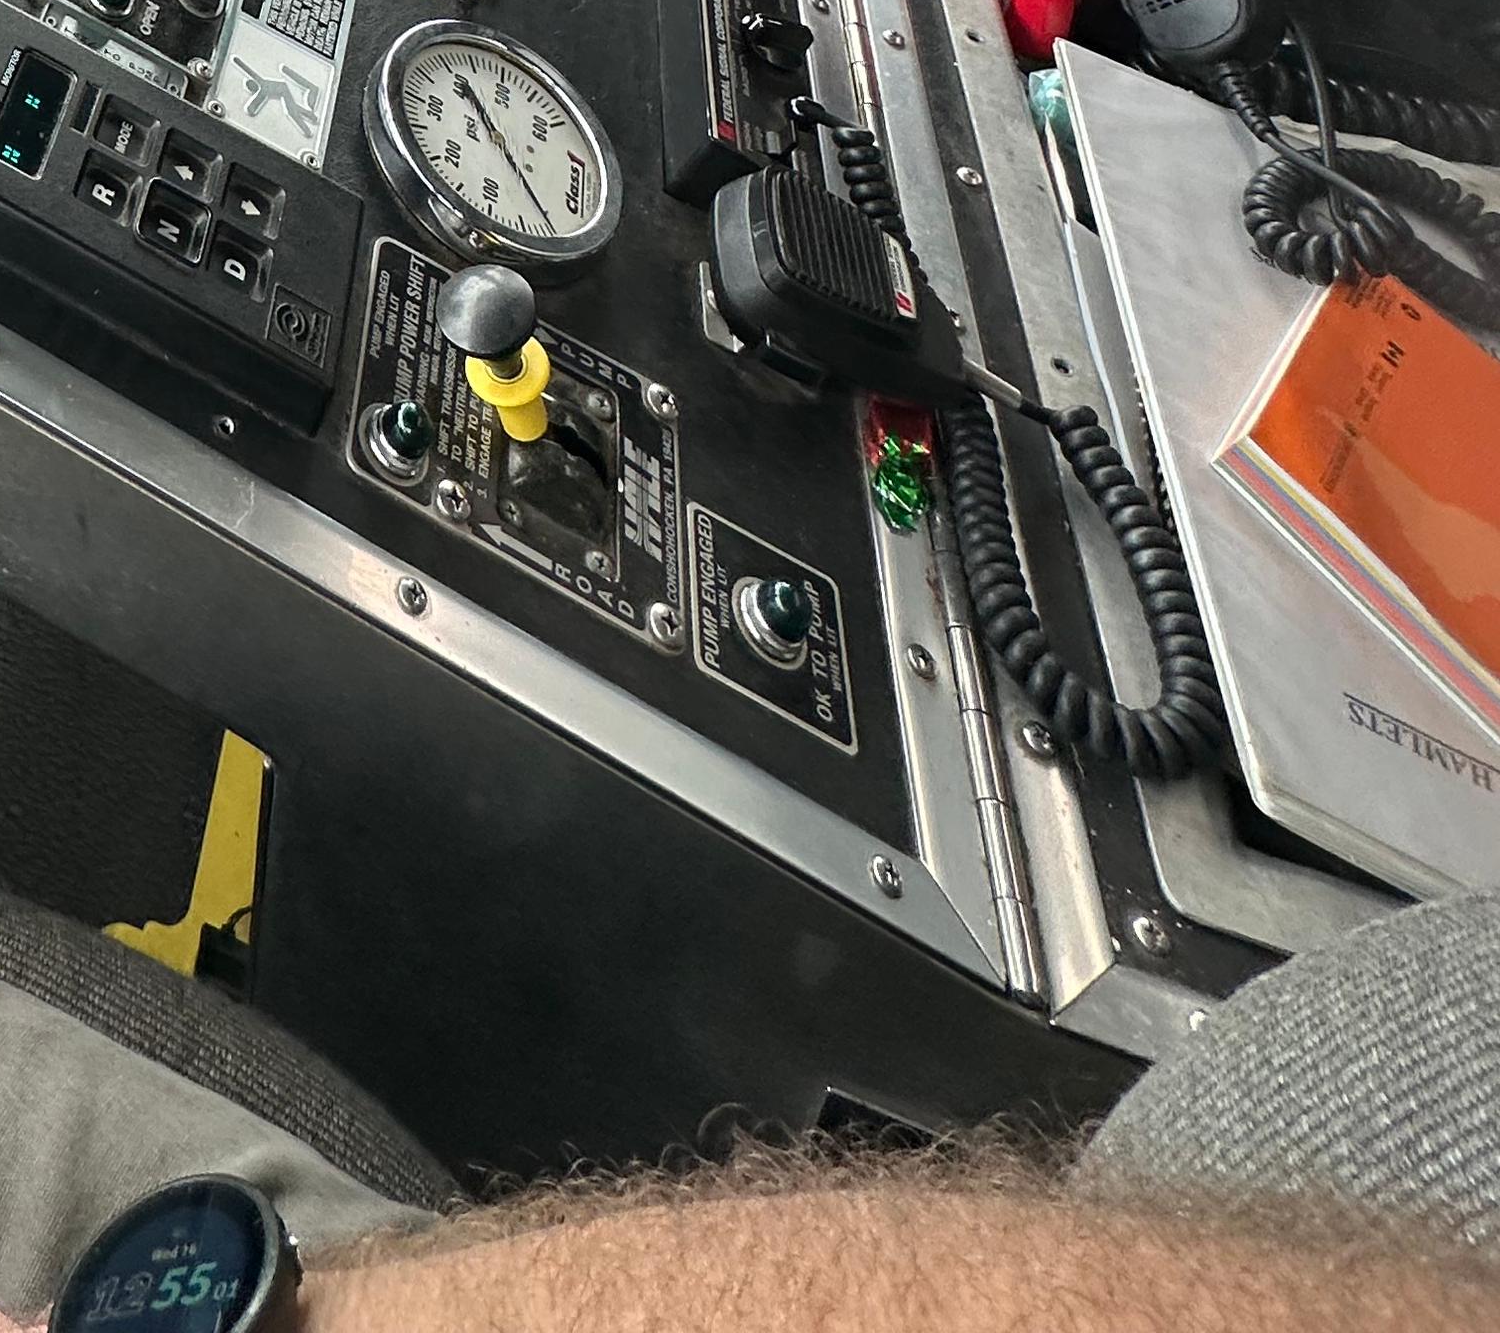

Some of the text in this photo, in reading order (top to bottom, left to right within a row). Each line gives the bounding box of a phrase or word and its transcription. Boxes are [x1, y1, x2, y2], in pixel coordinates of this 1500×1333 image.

[139, 0, 161, 35] OPEN
[1, 48, 23, 87] MONITOR
[717, 41, 730, 78] SIGNAL
[426, 95, 444, 121] 300
[495, 84, 511, 109] 500
[720, 77, 734, 124] FEDERAL
[113, 121, 134, 155] MODE
[464, 116, 481, 143] psi
[532, 115, 548, 142] 600
[444, 139, 462, 168] 200
[91, 183, 116, 207] R
[483, 177, 500, 205] 100
[156, 218, 181, 243] N
[223, 257, 247, 282] D
[407, 254, 427, 302] SHIFT
[369, 270, 391, 359] PUMP ENGAGED
[383, 292, 400, 347] WHEN LIT
[400, 302, 420, 361] POWER
[561, 343, 634, 390] PUMP
[437, 421, 450, 456] SHIFT
[467, 413, 479, 432] TO
[450, 445, 462, 463] TO
[464, 434, 477, 472] SHIFT
[478, 425, 493, 479] ENGAGE
[661, 464, 675, 485] PA
[555, 562, 636, 620] ROAD
[697, 513, 721, 670] PUMP ENGAGED
[716, 564, 731, 632] WHEN LIT
[803, 580, 834, 723] OK TO PUMP
[824, 625, 843, 693] WHEN LIT
[1348, 701, 1495, 793] HAMLETS
[150, 1261, 218, 1310] 55
